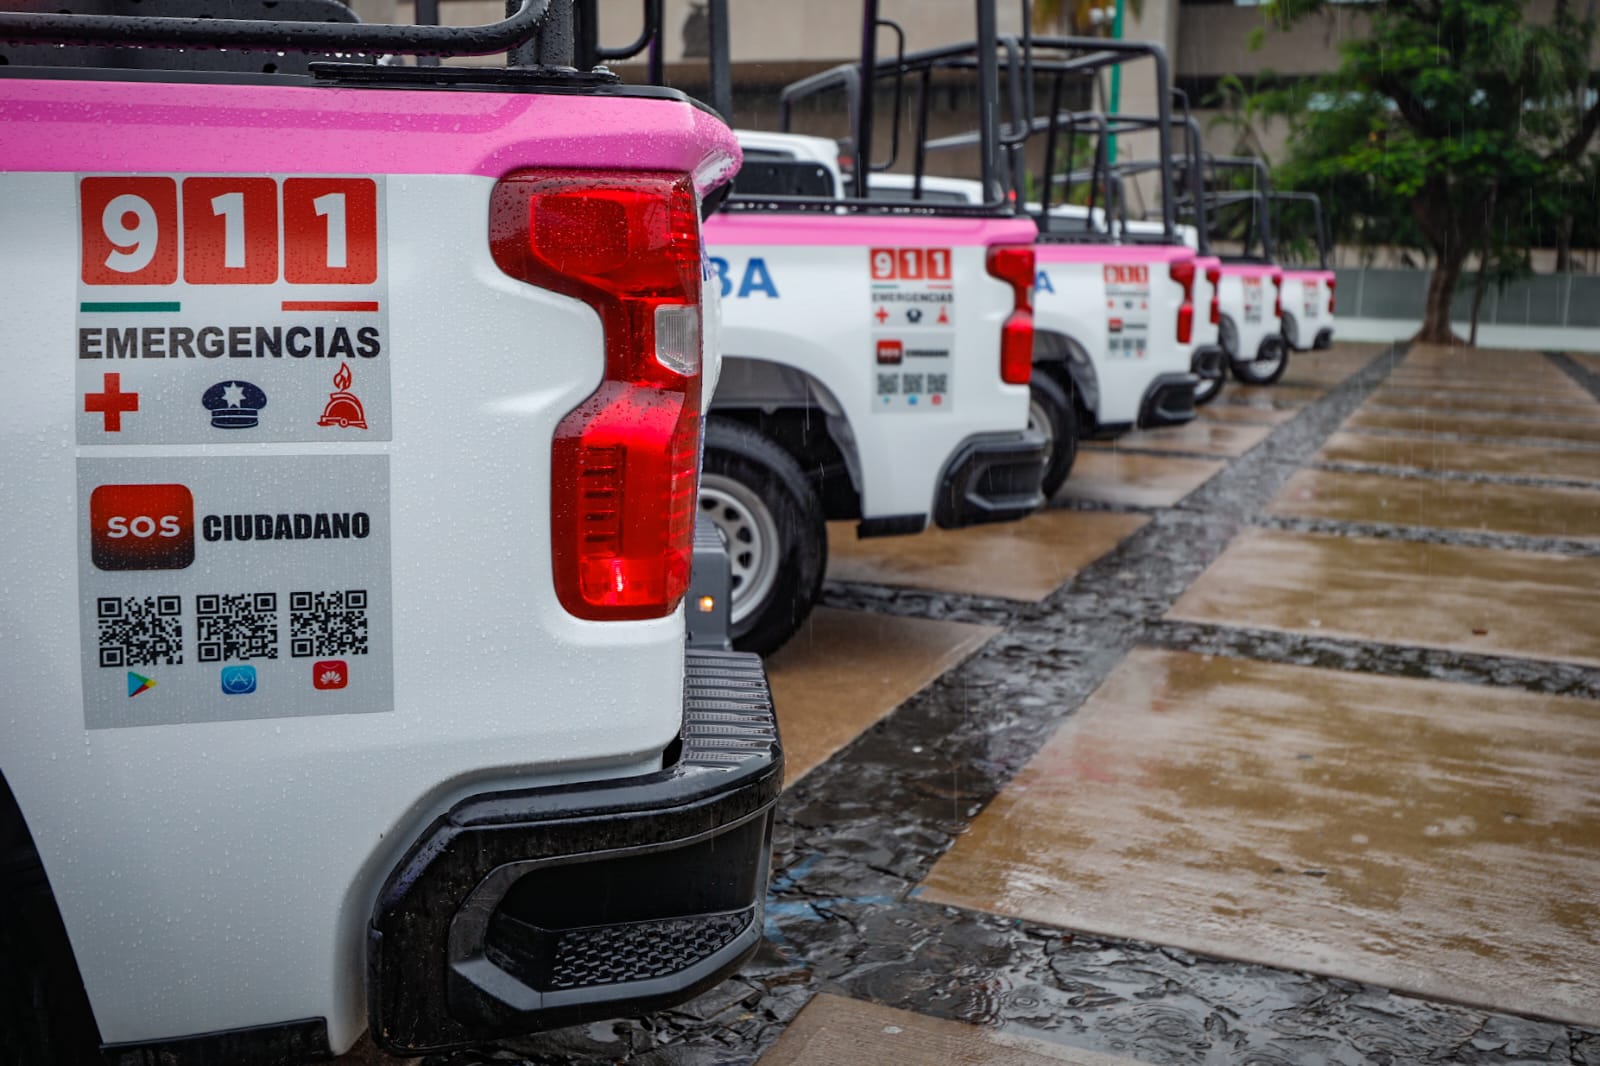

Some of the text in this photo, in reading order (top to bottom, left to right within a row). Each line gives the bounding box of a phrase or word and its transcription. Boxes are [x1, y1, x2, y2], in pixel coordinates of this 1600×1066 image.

[101, 191, 347, 274] 911
[874, 251, 945, 278] 911
[78, 325, 382, 360] EMERGENCIAS
[107, 511, 371, 542] SOS CIUDADANO
